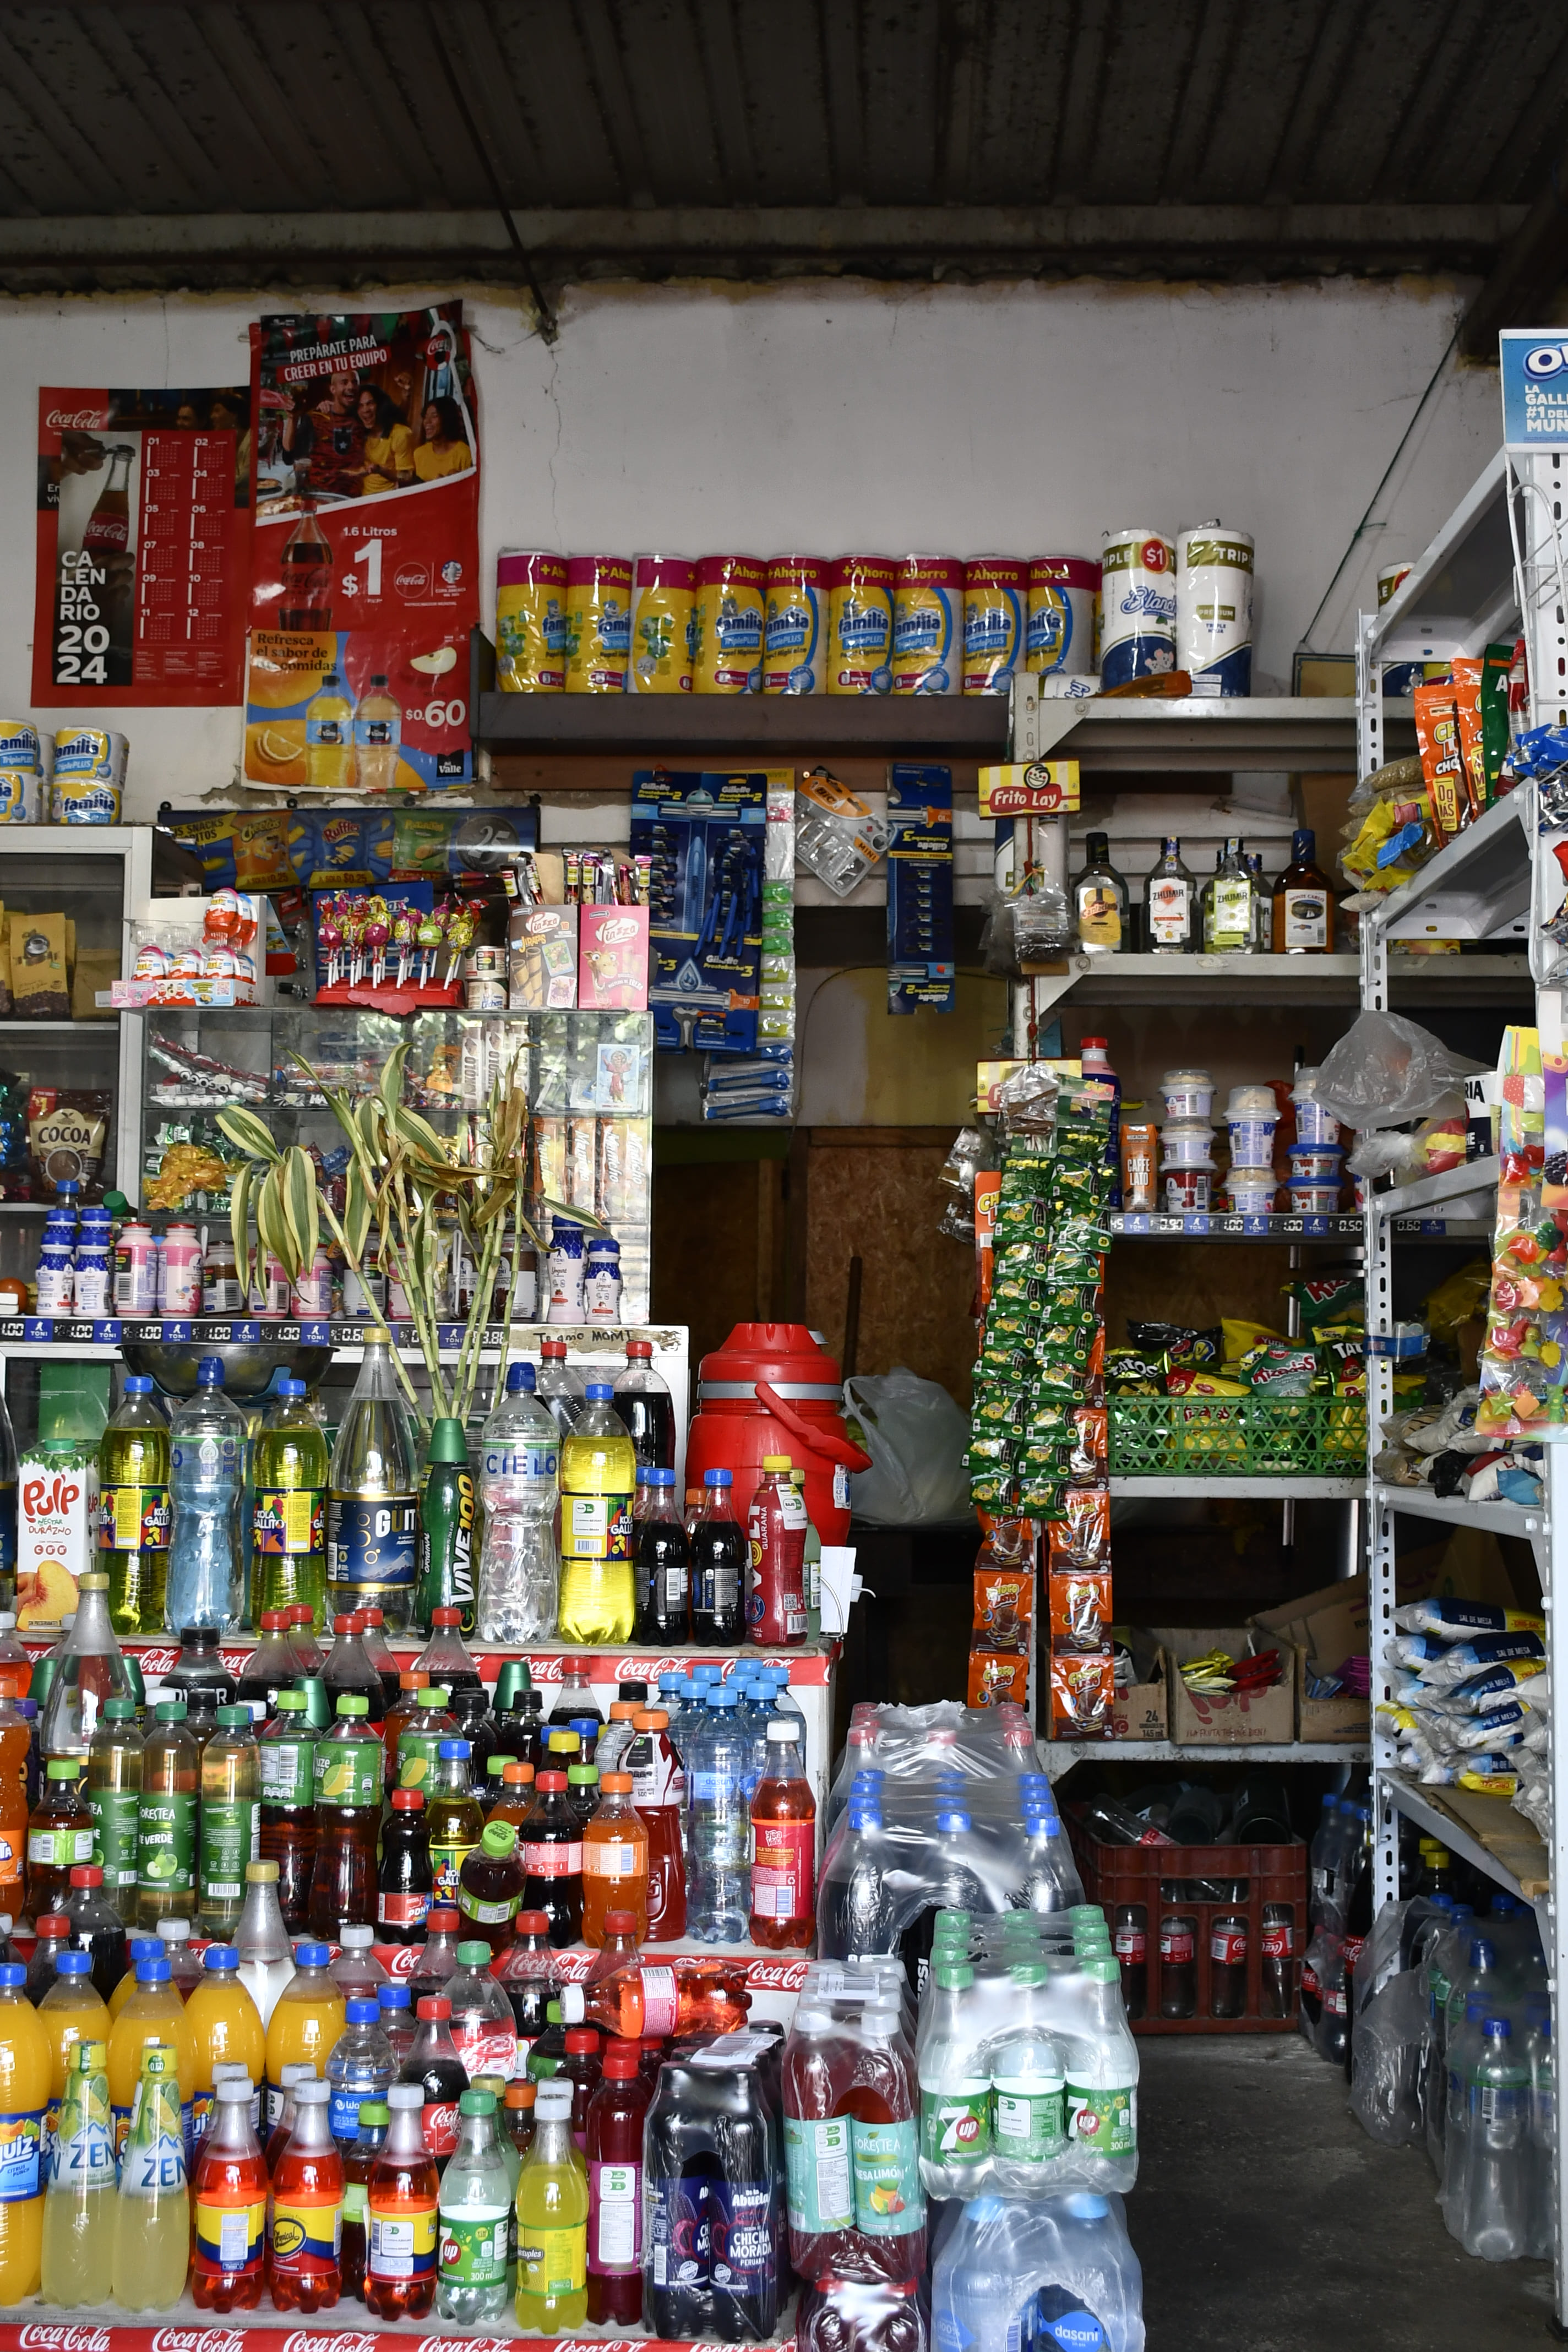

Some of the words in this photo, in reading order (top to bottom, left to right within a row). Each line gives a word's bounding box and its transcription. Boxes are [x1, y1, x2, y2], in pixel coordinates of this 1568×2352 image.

[290, 339, 347, 363] PREPÁRATE
[349, 335, 377, 353] PARA
[284, 364, 317, 382] CREER
[319, 361, 332, 375] EN
[335, 358, 348, 372] TU
[350, 349, 386, 369] EQUIPO
[1525, 385, 1540, 393] LA
[46, 409, 104, 429] Coca-Cola
[1526, 406, 1545, 418] #1
[1548, 410, 1568, 418] DEL
[86, 521, 127, 541] Coca-Cola
[343, 527, 359, 536] 1.6
[363, 527, 397, 536] Litros
[190, 541, 204, 549] 08
[61, 551, 93, 567] CA
[1146, 548, 1163, 565] $1
[61, 569, 106, 585] LEN
[396, 575, 427, 585] Coca-Cola
[61, 587, 92, 602] DA
[59, 605, 100, 620] RIO
[839, 612, 889, 633] familia
[57, 625, 110, 654] 20
[258, 633, 313, 645] Refresca
[257, 647, 268, 657] el
[271, 647, 309, 658] sabor
[312, 647, 328, 658] de
[57, 655, 108, 684] 24
[281, 660, 337, 671] comidas
[406, 699, 466, 728] $0.60
[0, 733, 36, 750] amilia
[439, 763, 462, 775] Valle
[64, 793, 115, 812] familia
[815, 786, 836, 804] BIC
[994, 790, 1027, 807] Frito
[1031, 790, 1058, 808] Lay
[187, 818, 224, 834] SNACKS
[241, 817, 281, 842] Cheetos
[323, 821, 361, 842] Ruffles
[857, 840, 878, 861] MINI
[344, 873, 367, 883] $0.25
[1152, 889, 1184, 901] ZHUMIR
[1217, 891, 1248, 903] ZHUMIR
[526, 912, 557, 934] Piazza
[599, 918, 636, 946] Piazza
[39, 1126, 91, 1145] COCOA
[1130, 1172, 1149, 1186] LATO
[1339, 1219, 1363, 1232] 0.50
[1397, 1219, 1420, 1232] 0.60
[551, 1267, 567, 1275] Yogurt
[30, 1330, 48, 1338] TONI
[487, 1454, 557, 1475] CIELO
[257, 1510, 275, 1520] KOLA
[29, 1525, 72, 1536] DURAZNO
[253, 1518, 285, 1529] GALLITO
[1517, 1646, 1531, 1655] MESA
[1145, 1710, 1158, 1722] 24
[1500, 1711, 1518, 1722] MESA
[145, 1833, 173, 1845] VERDE
[408, 1903, 430, 1918] PONY
[939, 2105, 977, 2151] 7up
[854, 2137, 902, 2153] FORESTEA
[1110, 2141, 1124, 2150] 300
[7, 2165, 26, 2175] CITRUS
[12, 2169, 30, 2179] PUNCH
[732, 2193, 770, 2207] Abuela
[733, 2231, 770, 2246] CHICHA
[729, 2243, 772, 2258] MORADA
[471, 2271, 484, 2280] 300
[485, 2271, 493, 2280] ml
[20, 2323, 112, 2352] Coca-Cola
[152, 2327, 248, 2352] Coca-Cola
[1055, 2324, 1099, 2342] dasani
[283, 2331, 381, 2352] Coca-Cola
